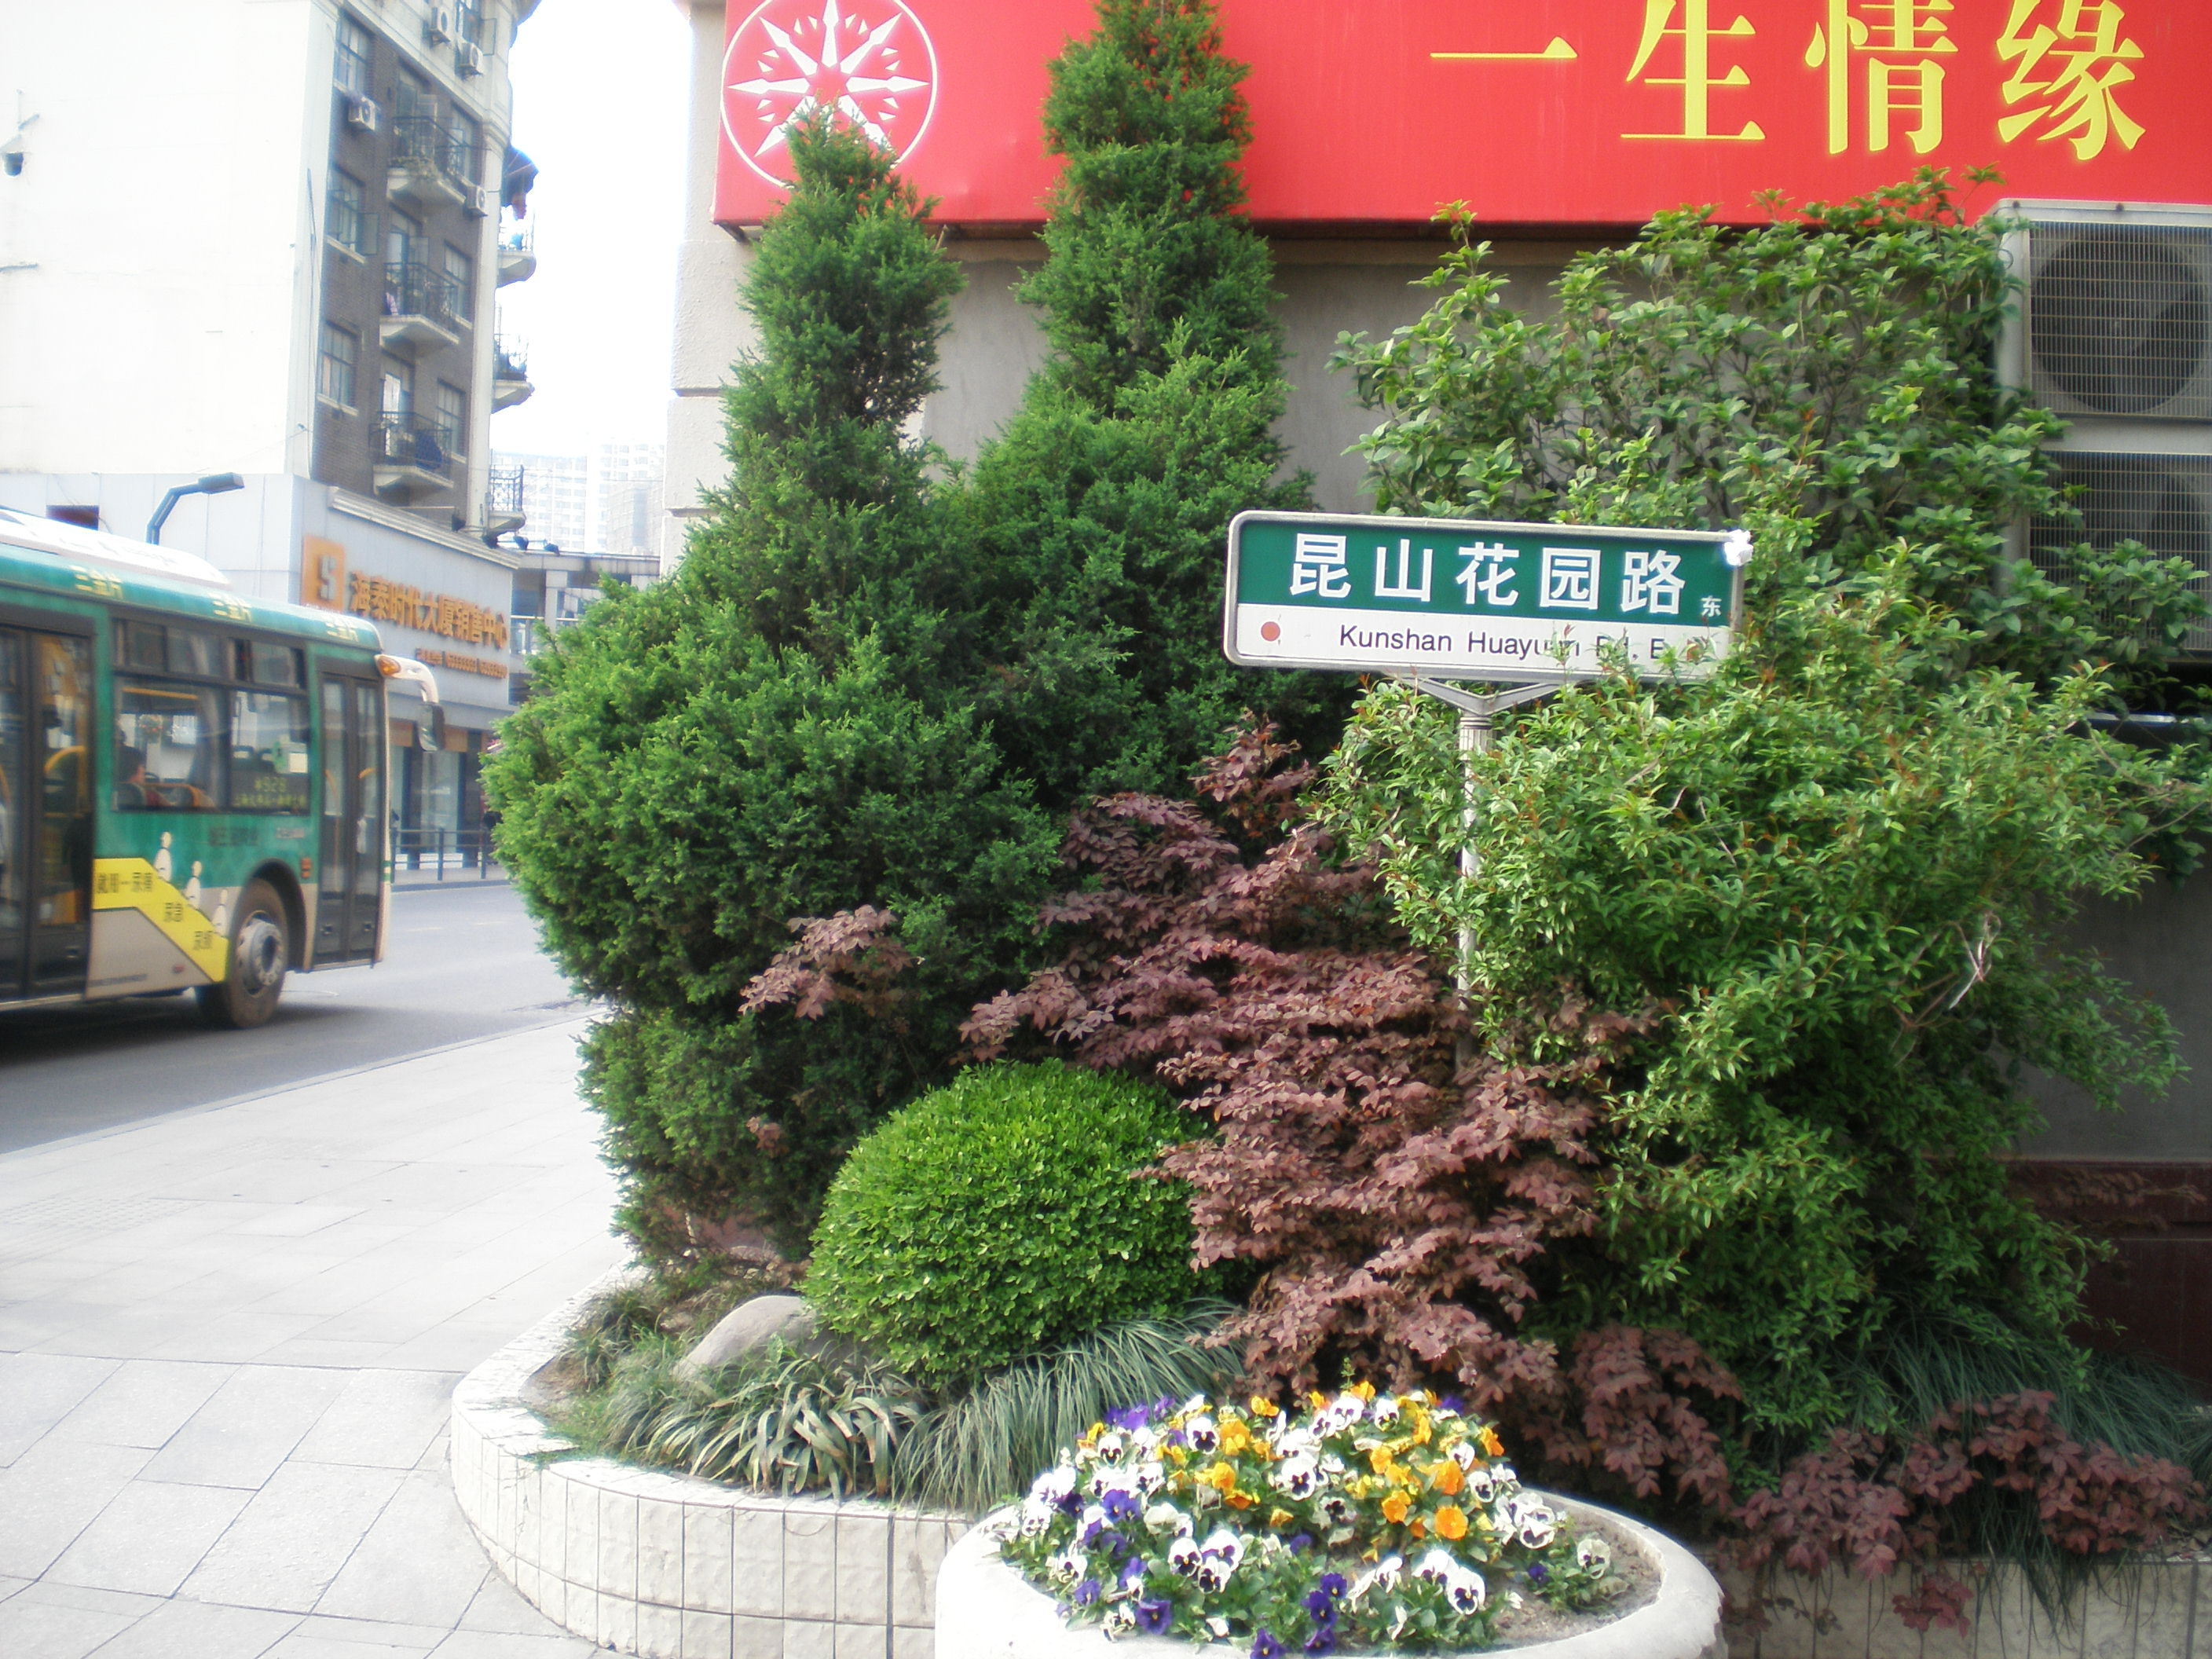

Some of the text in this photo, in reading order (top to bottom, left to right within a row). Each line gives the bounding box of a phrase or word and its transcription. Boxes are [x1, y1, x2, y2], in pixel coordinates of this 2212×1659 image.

[1430, 0, 2146, 159] 一生情缘
[1290, 532, 1722, 617] 昆山花园路 东
[1339, 625, 1452, 654] Kunshan
